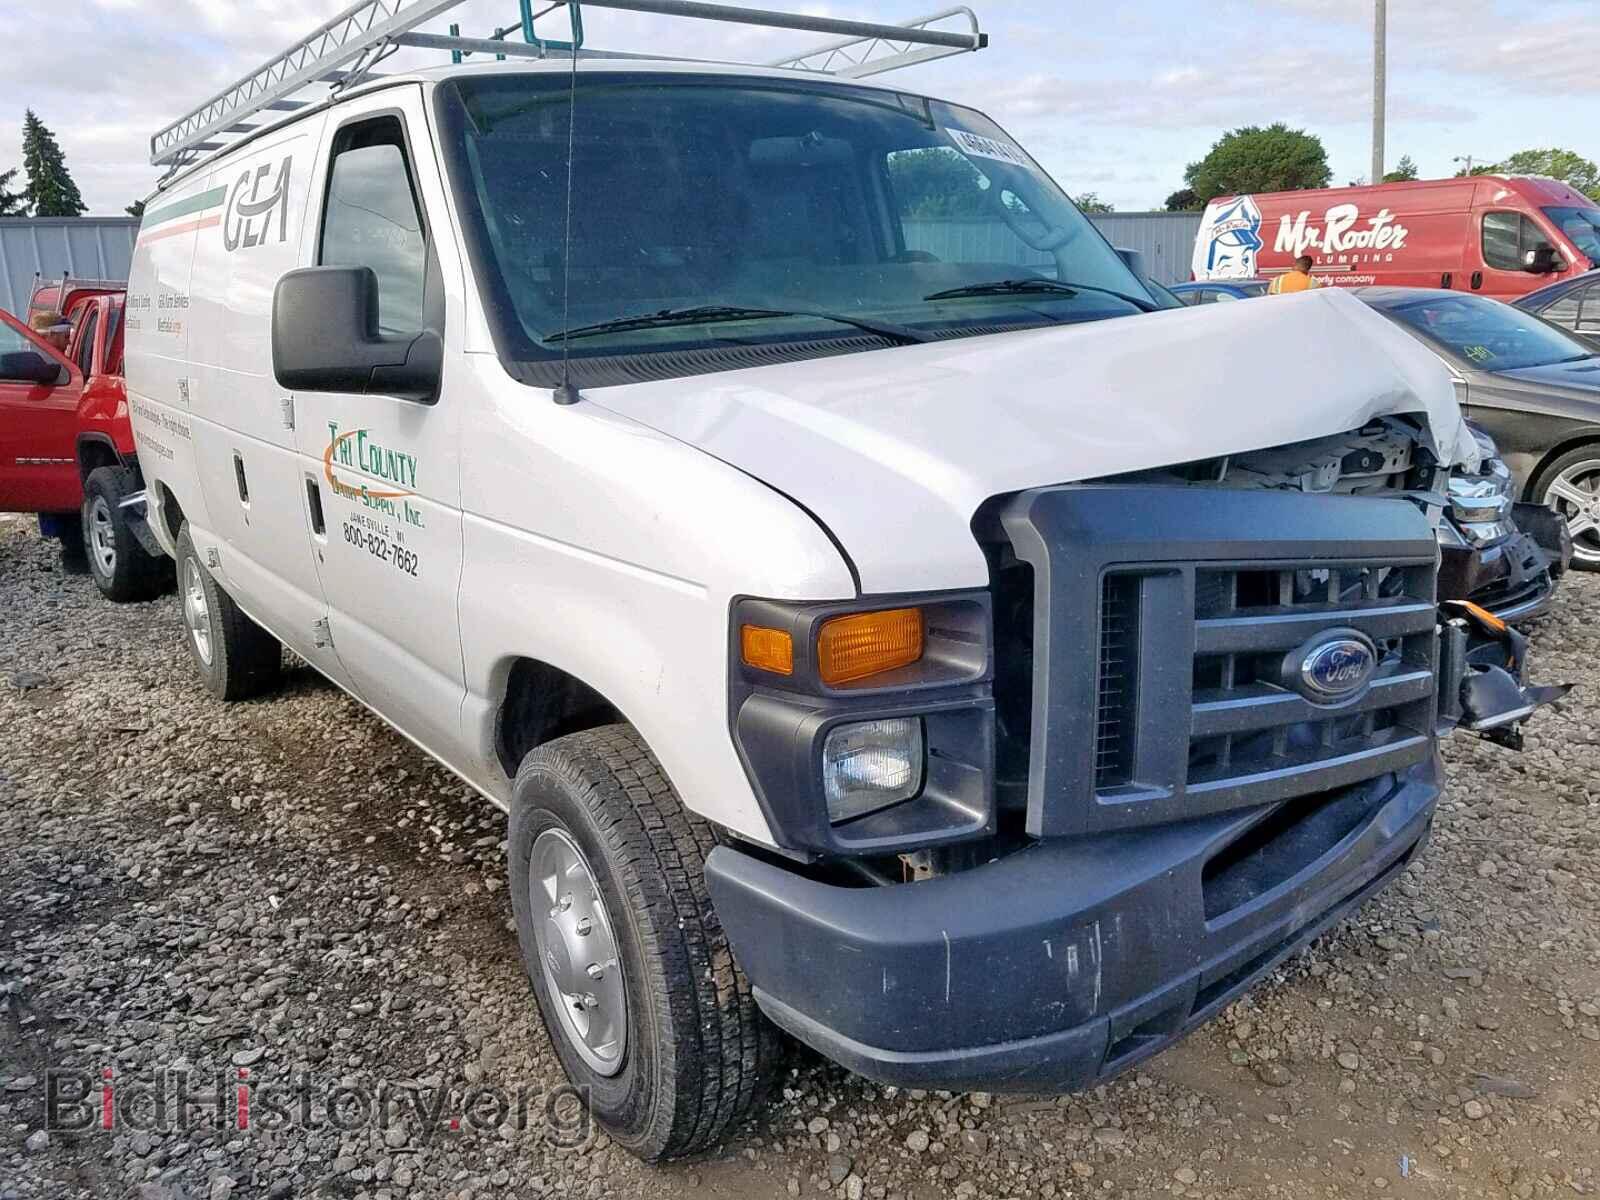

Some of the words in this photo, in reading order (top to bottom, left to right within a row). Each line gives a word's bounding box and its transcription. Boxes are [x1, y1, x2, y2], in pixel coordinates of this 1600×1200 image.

[224, 155, 293, 252] GEA
[1273, 210, 1323, 259] Mr.
[1322, 203, 1409, 254] Rooter
[1316, 253, 1393, 265] LUMBING
[1335, 274, 1376, 285] company
[343, 522, 418, 577] 800-822-7662
[1326, 650, 1364, 682] Ford
